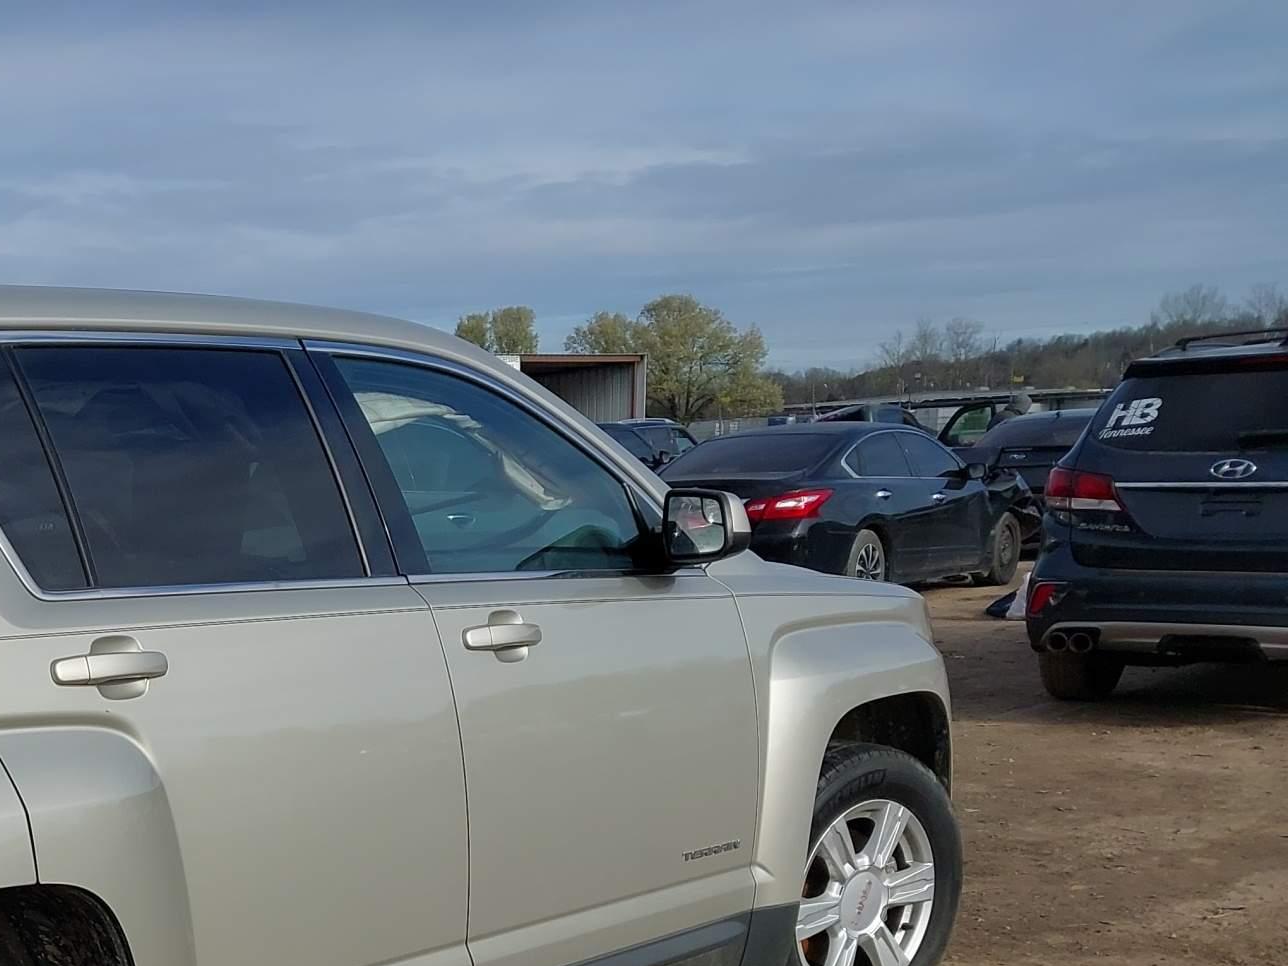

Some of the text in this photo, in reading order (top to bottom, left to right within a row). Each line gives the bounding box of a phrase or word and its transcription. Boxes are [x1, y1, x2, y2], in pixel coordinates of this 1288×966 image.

[1105, 397, 1164, 428] HB
[1099, 426, 1155, 440] Tennessee
[681, 839, 742, 862] TERRAIN
